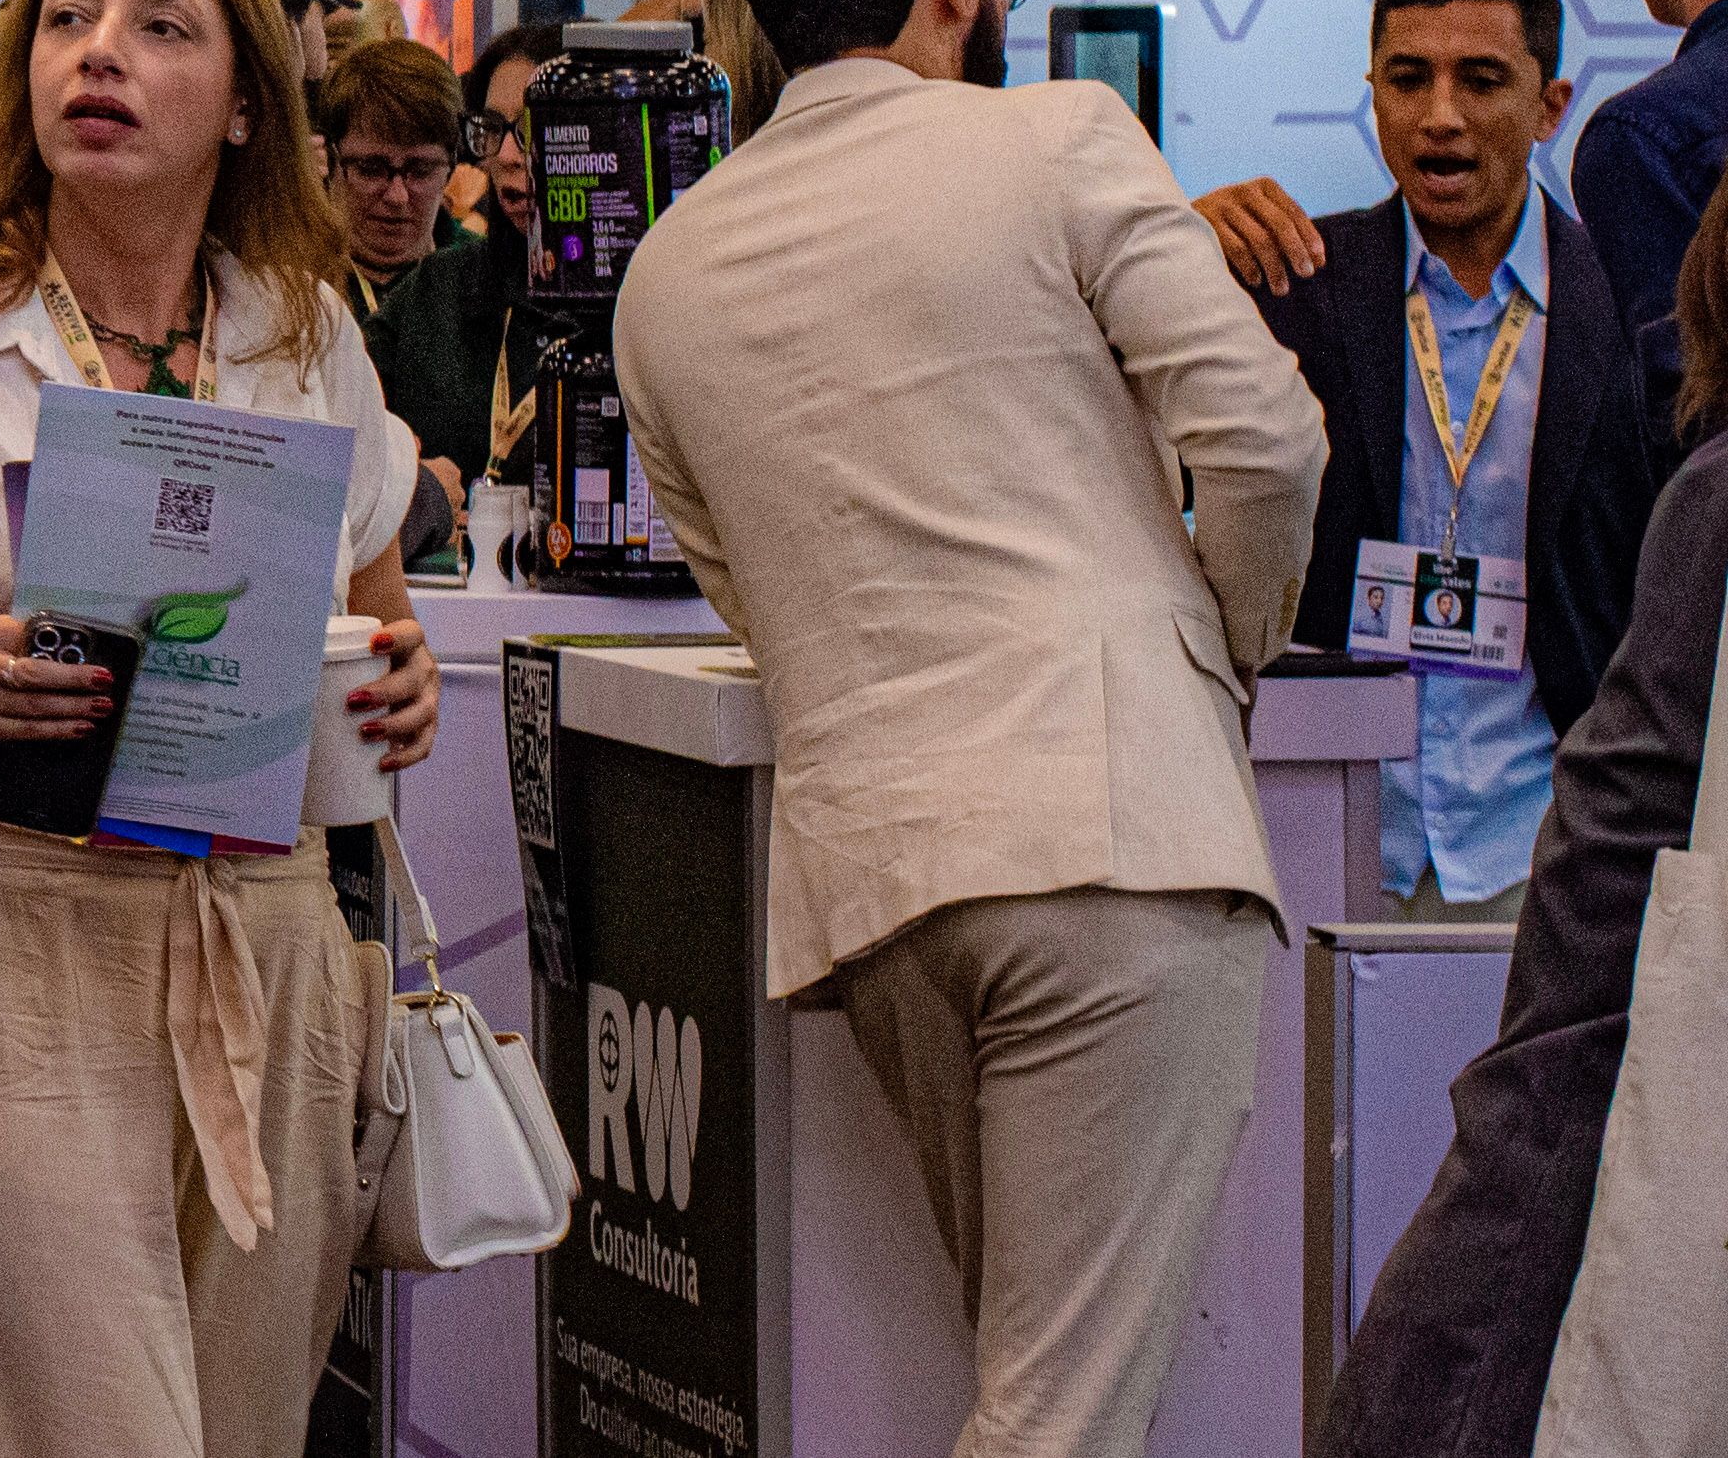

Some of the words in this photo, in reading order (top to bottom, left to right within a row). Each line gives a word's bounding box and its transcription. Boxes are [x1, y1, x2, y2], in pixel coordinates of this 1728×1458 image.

[545, 125, 590, 142] ALIMENTO
[546, 153, 618, 174] CACHORROS
[547, 189, 587, 223] CBD
[587, 981, 702, 1213] RW
[590, 1198, 699, 1307] Consultoria
[555, 1316, 578, 1366] Sua
[638, 1368, 675, 1414] nossa
[580, 1382, 598, 1430] Do
